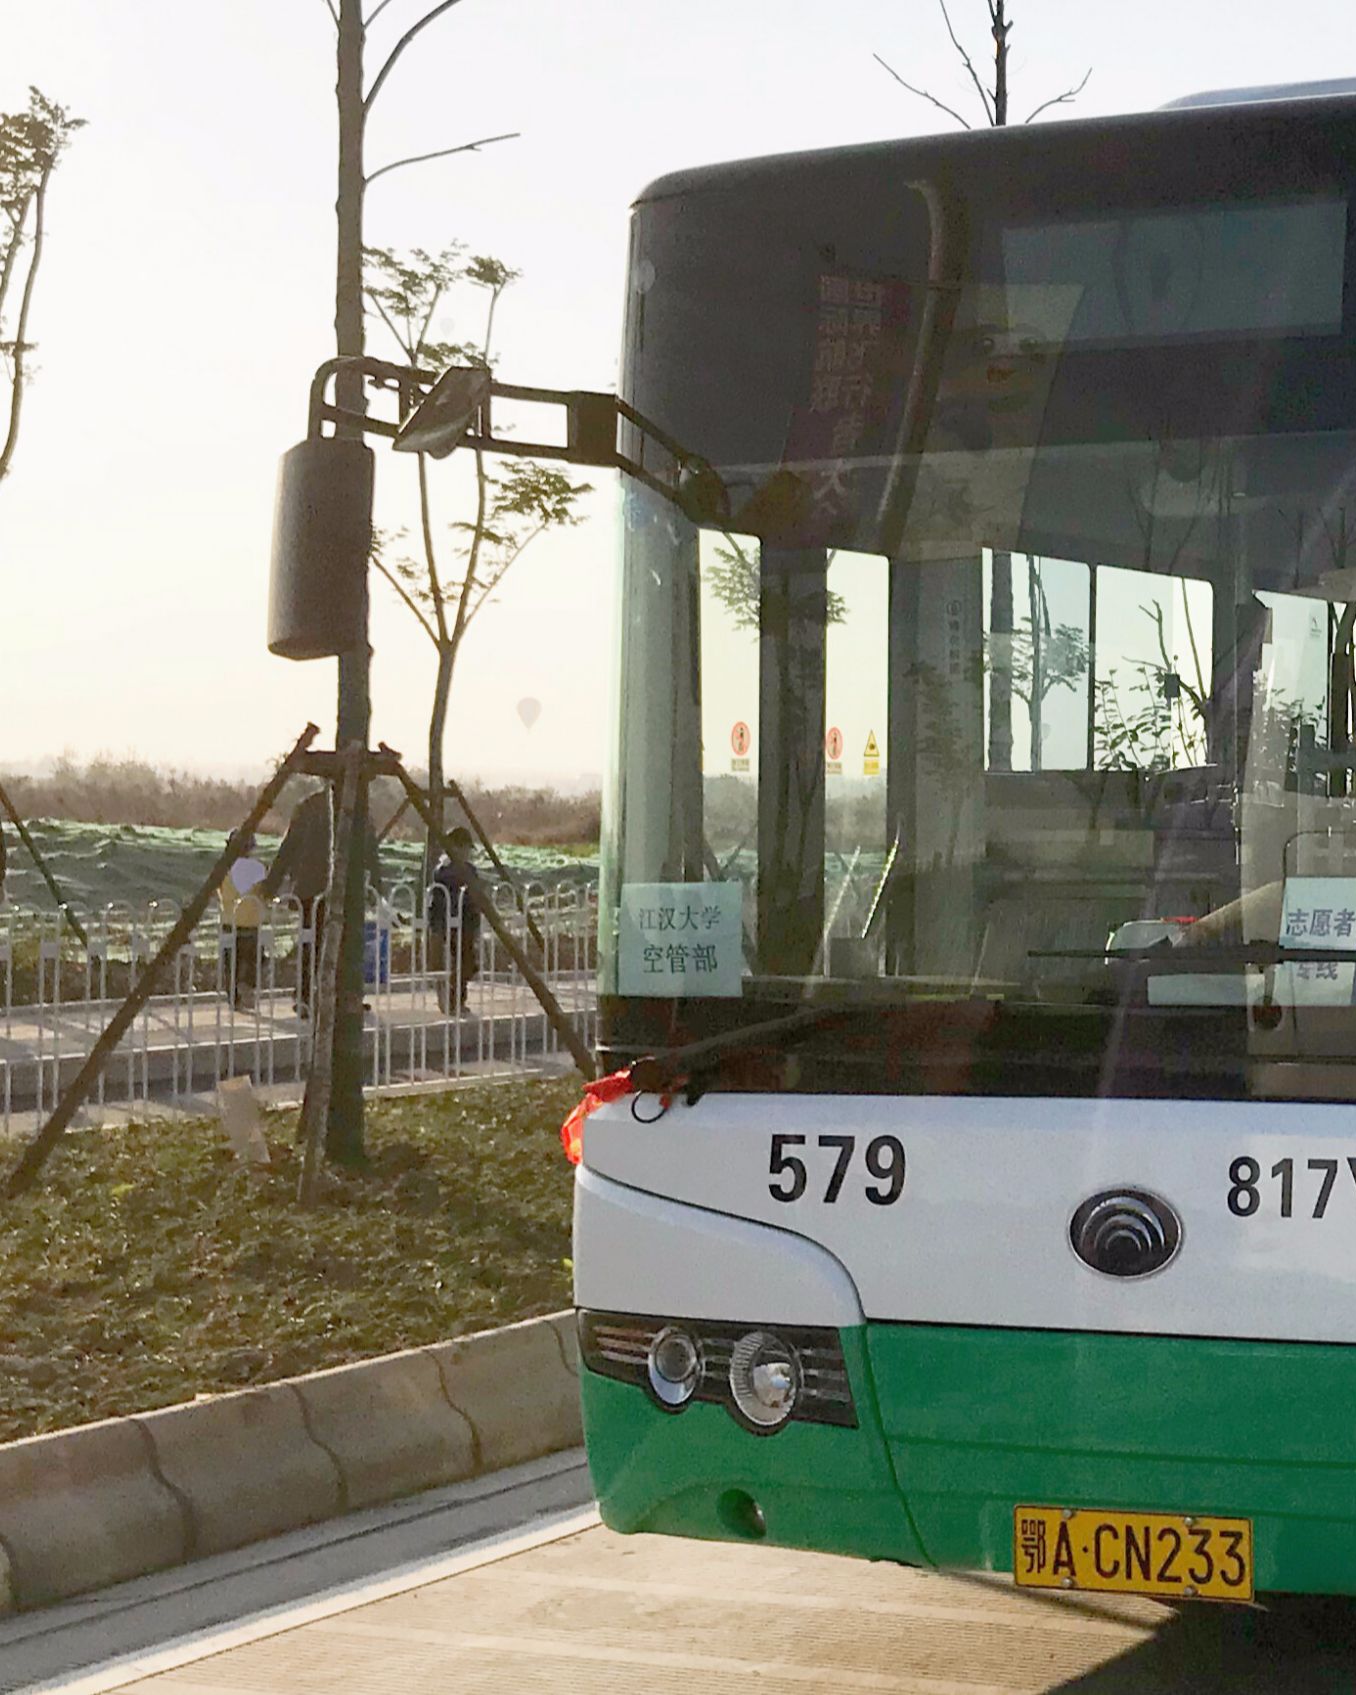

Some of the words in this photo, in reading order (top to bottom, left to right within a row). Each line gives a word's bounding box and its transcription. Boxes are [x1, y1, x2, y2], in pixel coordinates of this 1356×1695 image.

[638, 904, 722, 932] 江汉大学
[1286, 907, 1356, 939] 志愿者
[642, 943, 719, 975] 空管部
[768, 1134, 907, 1206] 579
